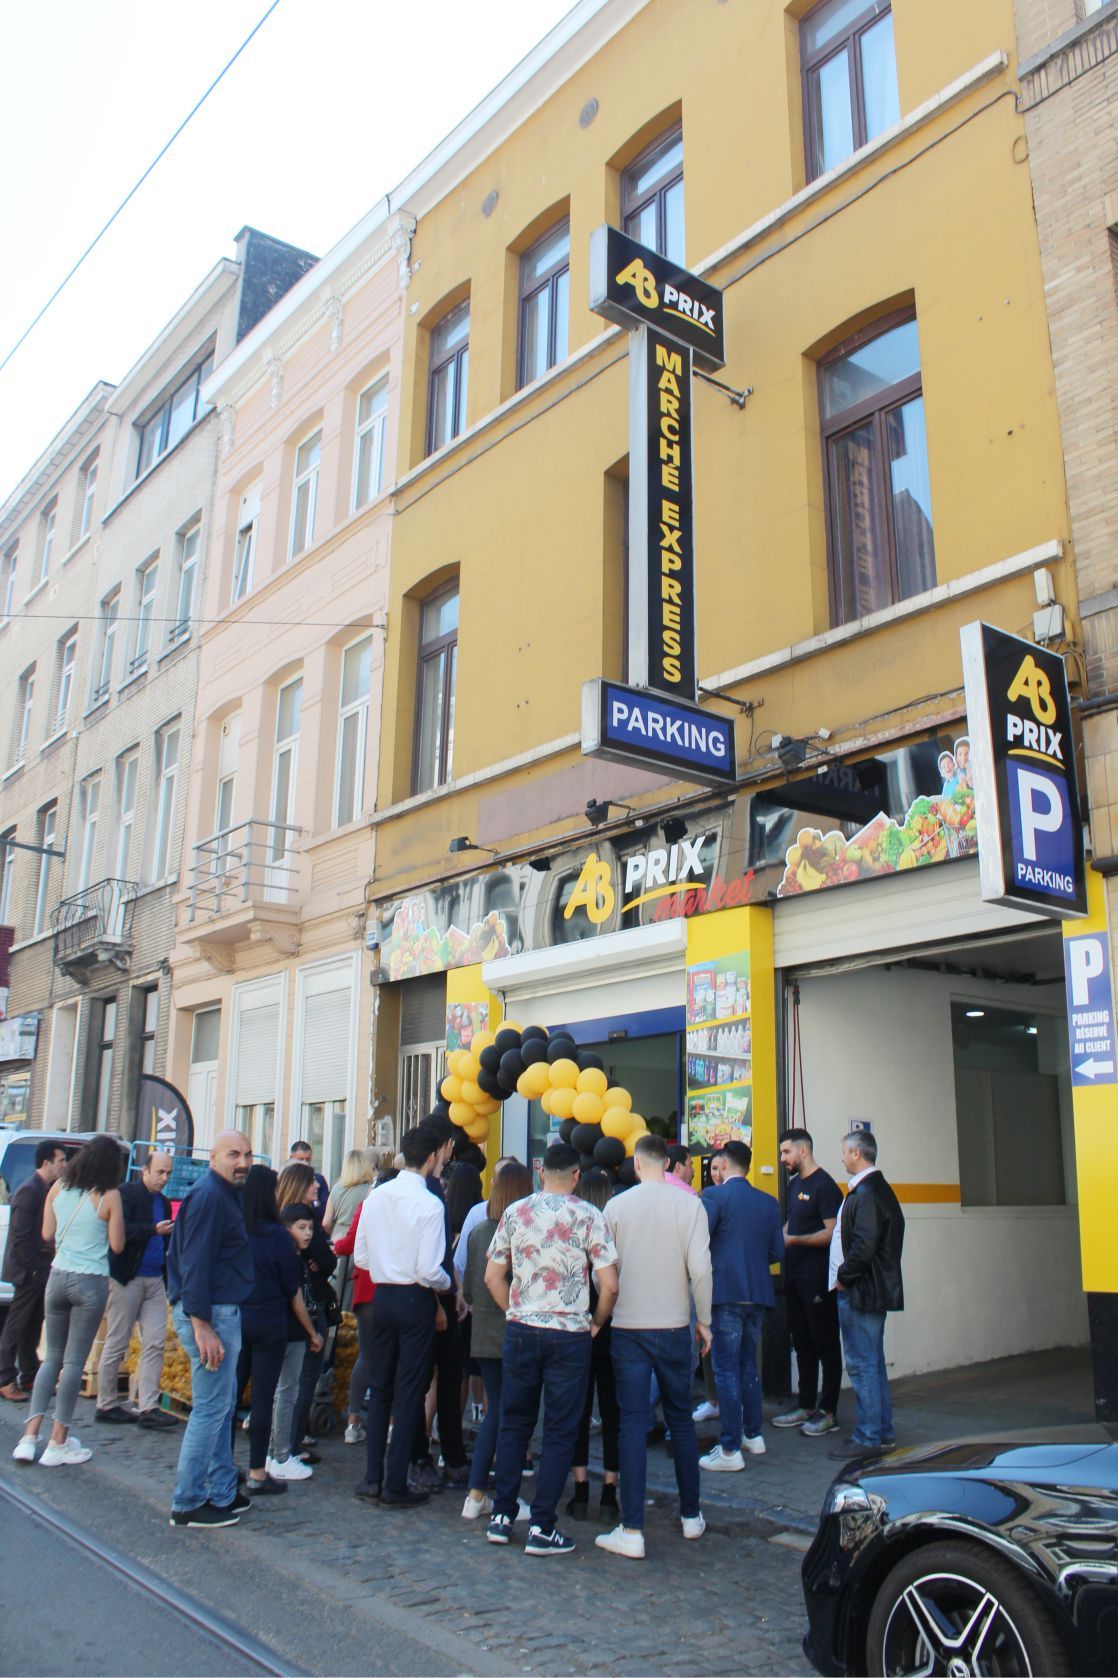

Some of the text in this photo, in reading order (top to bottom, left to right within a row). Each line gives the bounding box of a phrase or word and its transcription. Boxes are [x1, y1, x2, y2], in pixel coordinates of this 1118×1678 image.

[663, 284, 715, 330] PRIX
[656, 343, 683, 684] MARCHÉ EXPRESS
[612, 700, 726, 758] PARKING
[1007, 713, 1063, 760] PRIX
[1017, 767, 1063, 862] P
[625, 836, 706, 893] PRIX
[1017, 863, 1073, 893] PARKING
[653, 866, 756, 924] market
[1069, 938, 1104, 1007] P
[1072, 1010, 1109, 1026] PARKING
[1074, 1040, 1110, 1054] AU CLIENT
